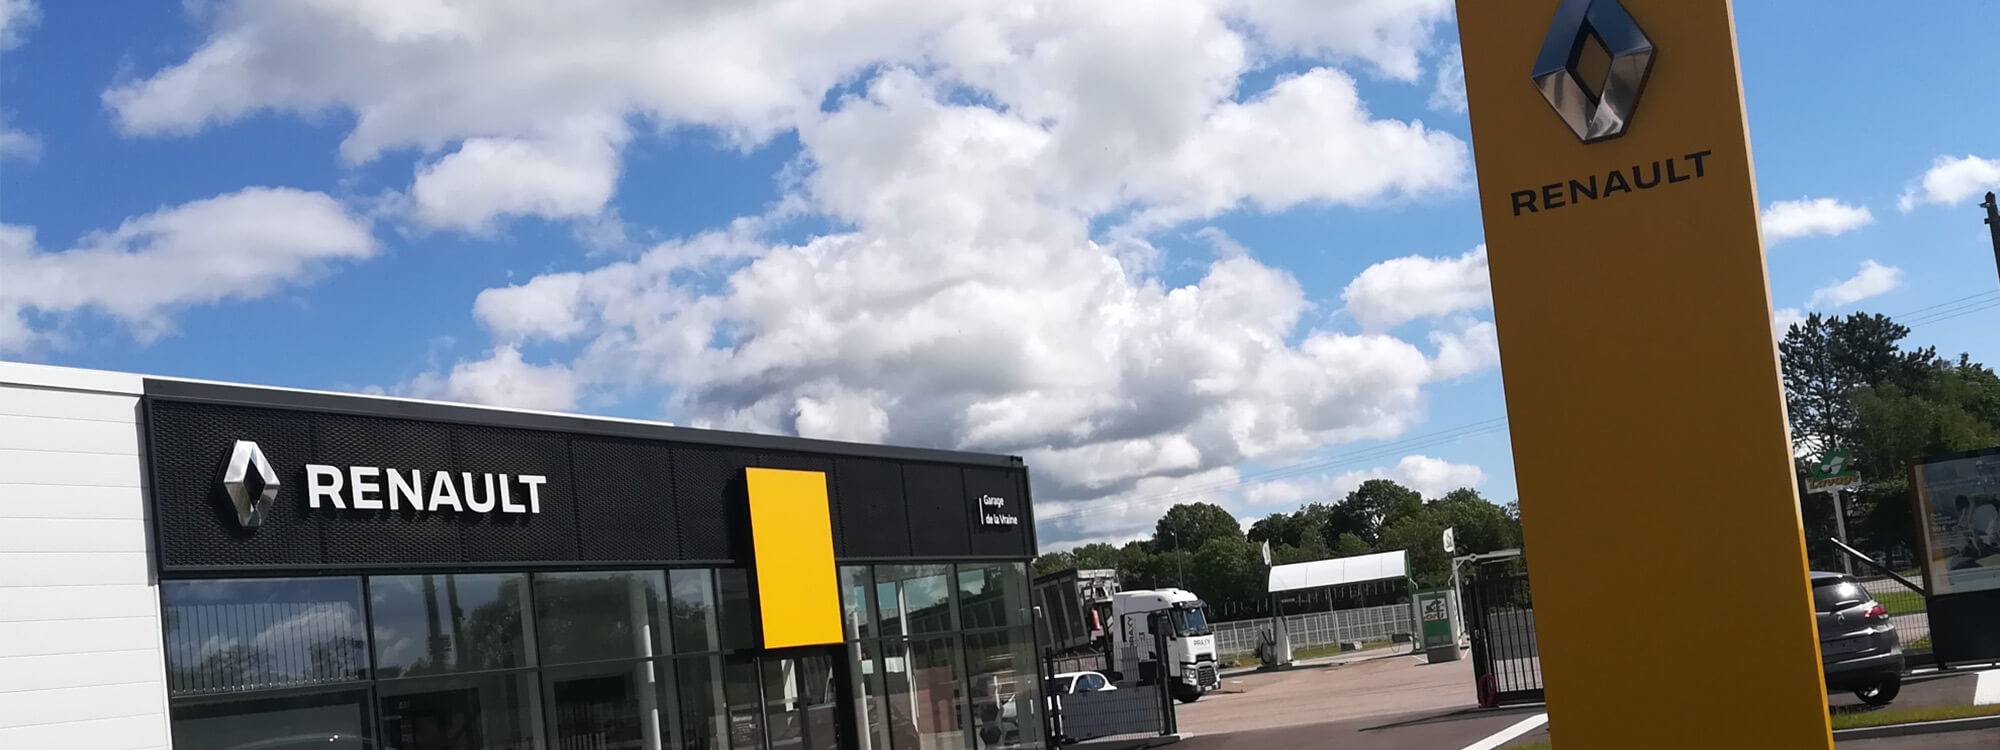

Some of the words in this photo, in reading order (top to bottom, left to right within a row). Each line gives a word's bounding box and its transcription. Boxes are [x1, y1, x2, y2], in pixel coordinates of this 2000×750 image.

[1511, 150, 1712, 216] RENAULT
[306, 464, 547, 513] RENAULT
[983, 494, 1004, 508] Garage
[986, 513, 993, 524] de
[993, 513, 1000, 524] la
[999, 513, 1018, 525] Vraine
